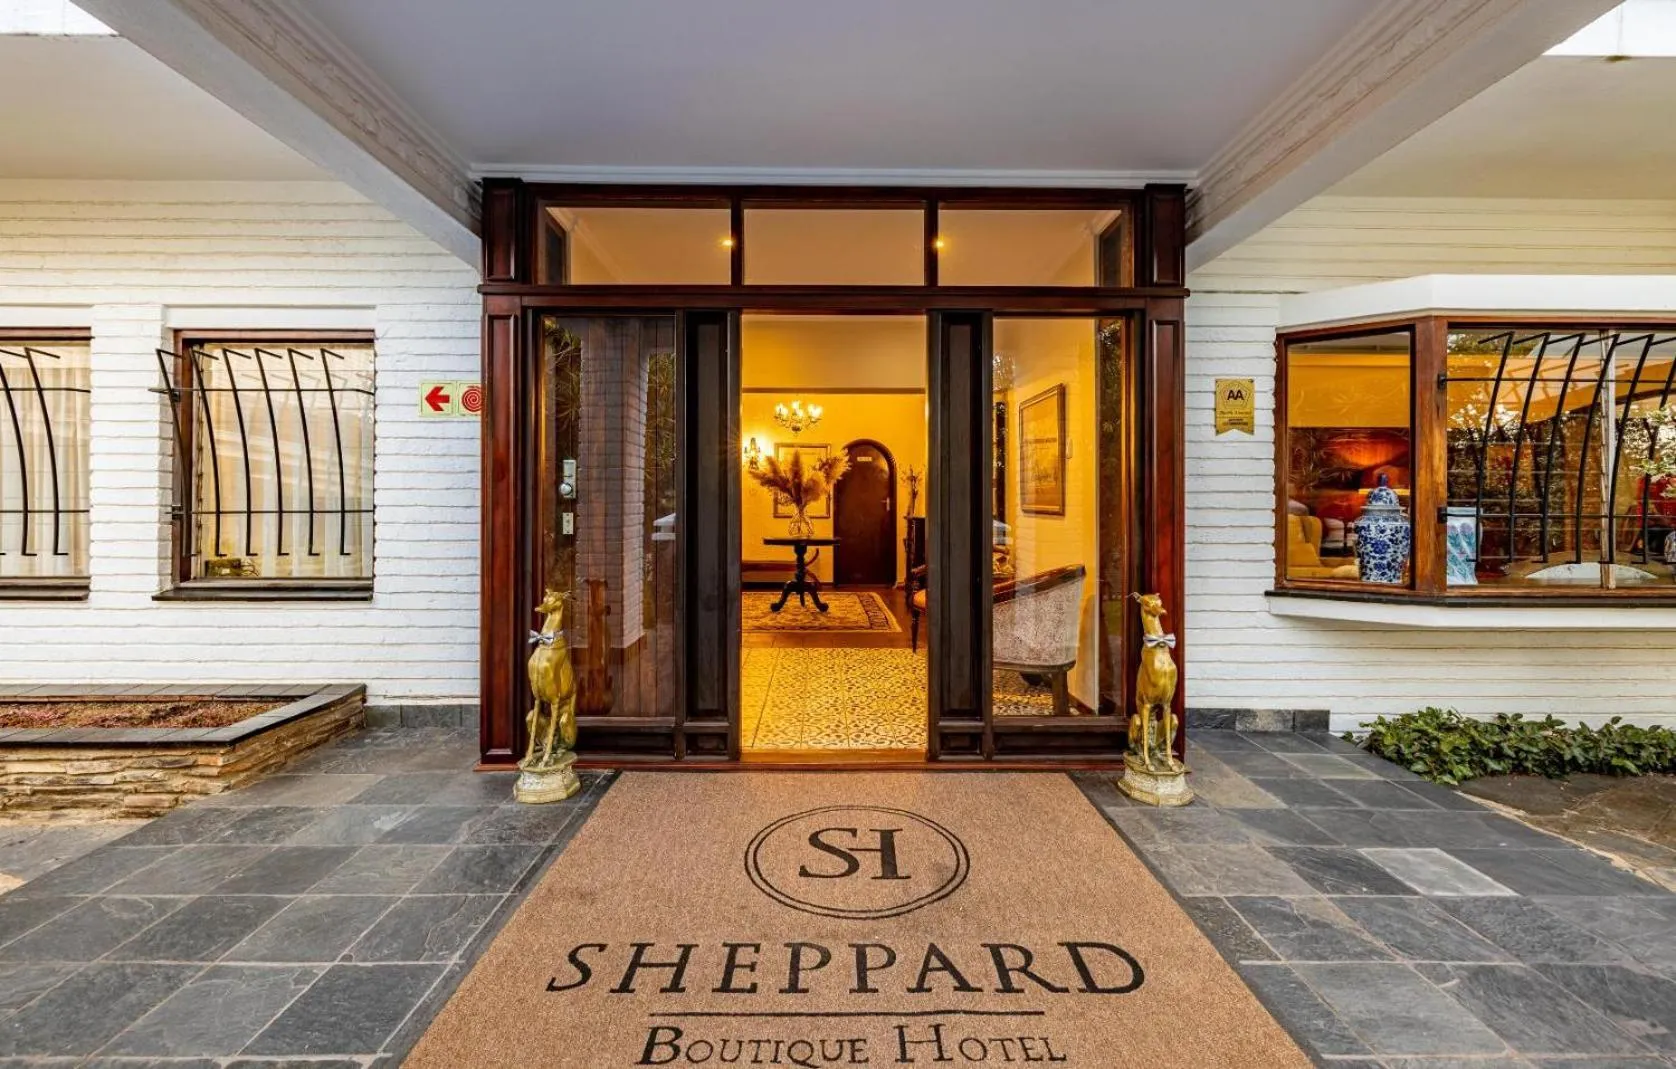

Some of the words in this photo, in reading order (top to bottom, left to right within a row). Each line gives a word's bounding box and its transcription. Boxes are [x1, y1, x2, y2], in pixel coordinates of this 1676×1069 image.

[1227, 389, 1245, 401] AA
[799, 827, 912, 880] SH
[545, 941, 1146, 994] SHEPPARD
[635, 1025, 868, 1069] BOUTIQUE
[892, 1023, 1067, 1063] HOTEL
